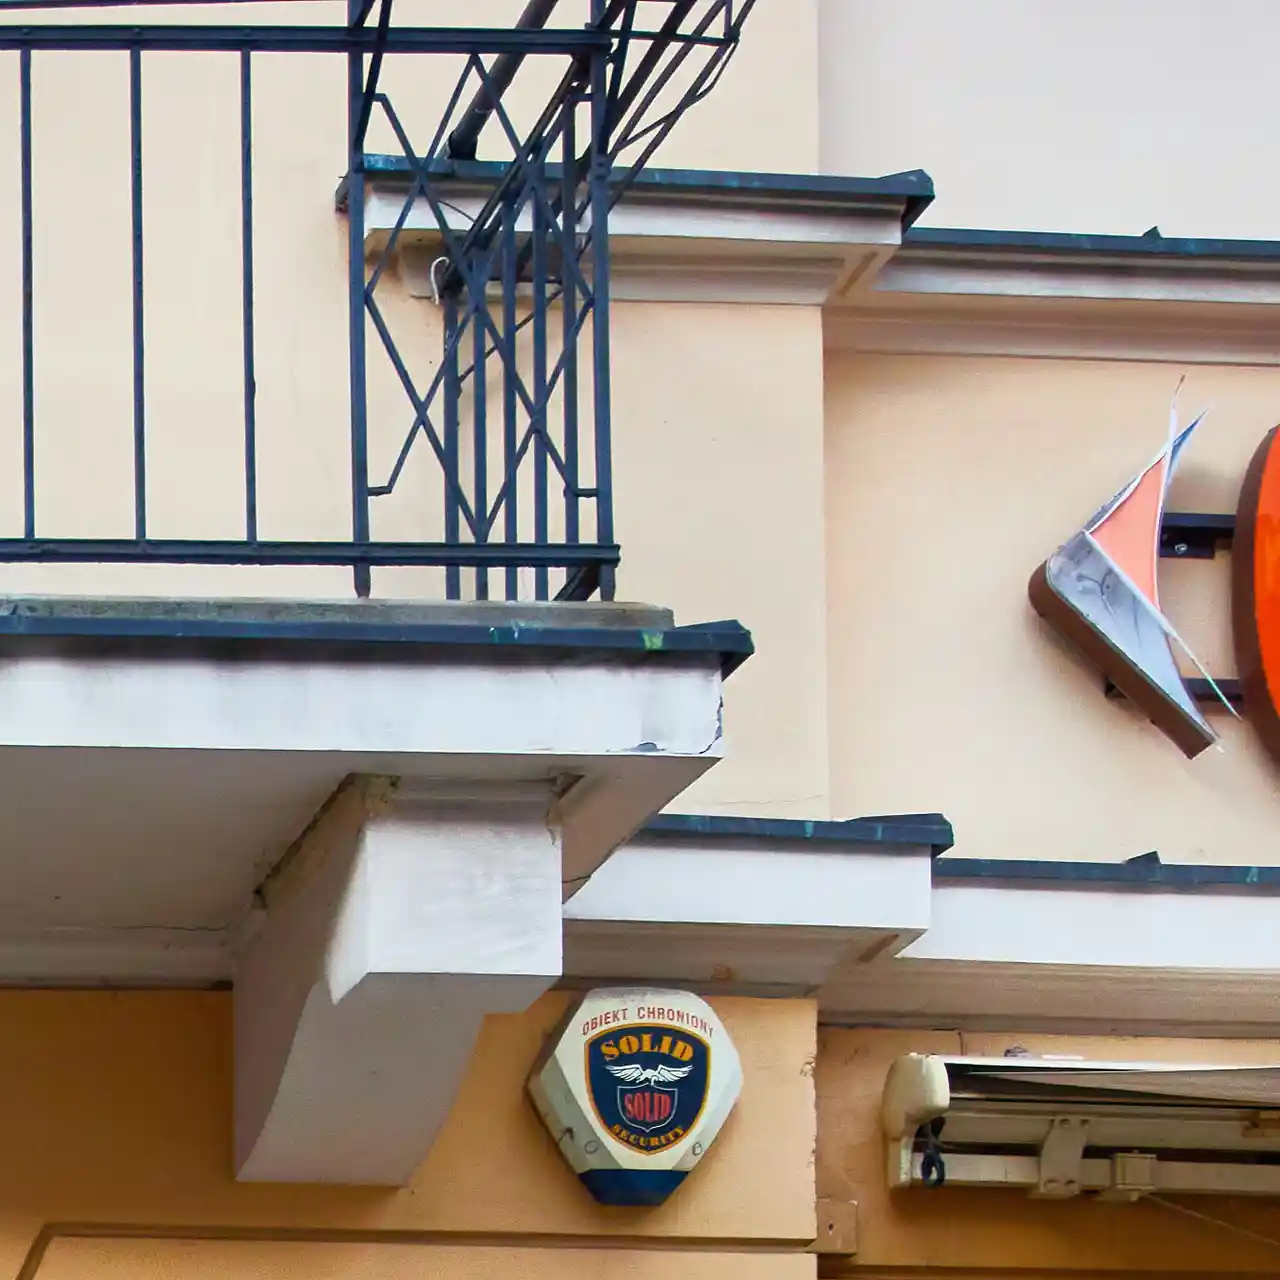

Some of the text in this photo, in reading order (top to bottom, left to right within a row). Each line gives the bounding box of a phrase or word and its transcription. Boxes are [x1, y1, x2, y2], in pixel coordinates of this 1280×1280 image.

[582, 1005, 717, 1037] OBIEKT CHRONIONY
[599, 1031, 694, 1062] SOLID
[624, 1091, 671, 1122] SOLID
[610, 1124, 686, 1147] SECURITY
